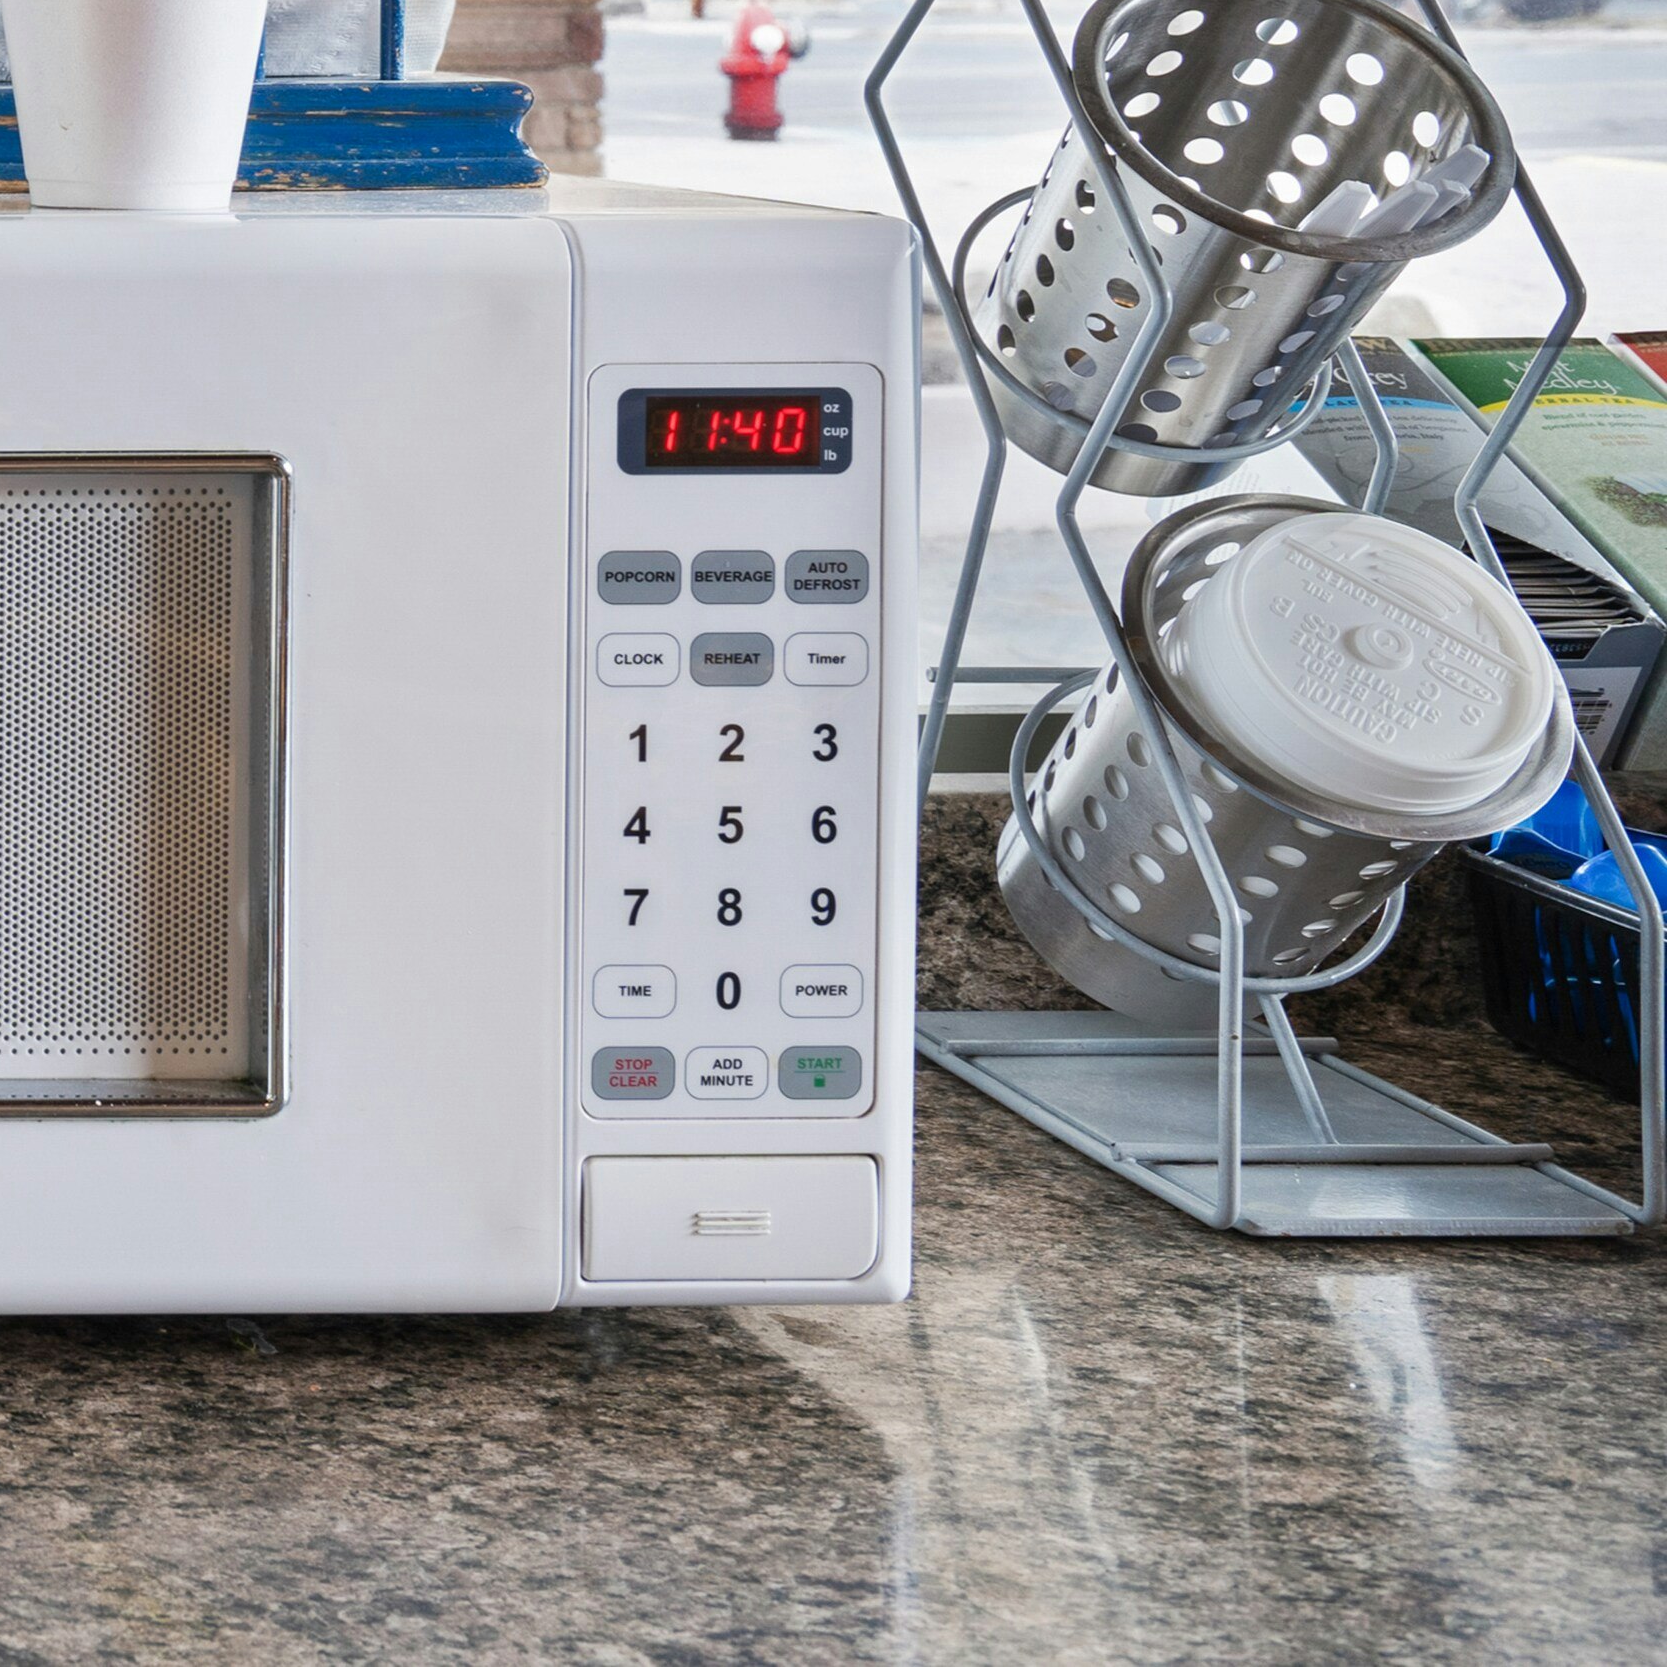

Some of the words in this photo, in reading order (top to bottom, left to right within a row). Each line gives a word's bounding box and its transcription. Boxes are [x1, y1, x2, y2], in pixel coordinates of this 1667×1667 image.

[823, 402, 841, 414] oz
[661, 407, 808, 454] 11:40
[823, 425, 850, 438] cup
[823, 449, 838, 462] lb
[604, 570, 676, 585] POPCORN
[694, 570, 774, 584] BEVERAGE
[807, 561, 848, 575] AUTO
[793, 578, 861, 592] DEFROST
[1319, 568, 1379, 608] COVER
[1269, 595, 1296, 619] B
[1300, 612, 1341, 644] CS
[1381, 604, 1433, 638] WITH
[613, 652, 665, 666] CLOCK
[703, 652, 761, 665] REHEAT
[807, 652, 847, 665] Timer
[1291, 630, 1345, 668] CARE
[1435, 634, 1484, 668] HERE
[1297, 654, 1340, 686] HOT
[1347, 662, 1402, 700] WITH
[1341, 679, 1369, 703] BE
[1416, 680, 1442, 703] C
[1292, 673, 1398, 745] CAUTION
[1380, 702, 1419, 732] MAY
[1405, 698, 1443, 725] SIP
[1459, 703, 1486, 727] S
[628, 723, 648, 763] 1
[717, 723, 746, 763] 2
[811, 723, 840, 763] 3
[622, 806, 652, 845] 4
[717, 805, 745, 845] 5
[810, 805, 838, 845] 6
[622, 888, 650, 927] 7
[716, 887, 744, 927] 8
[809, 887, 838, 927] 9
[618, 984, 653, 998] TIME
[715, 971, 743, 1011] 0
[794, 983, 849, 998] POWER
[614, 1057, 654, 1072] STOP
[712, 1057, 744, 1071] ADD
[796, 1056, 844, 1070] START
[608, 1074, 658, 1089] CLEAR
[699, 1073, 755, 1088] MINUTE
